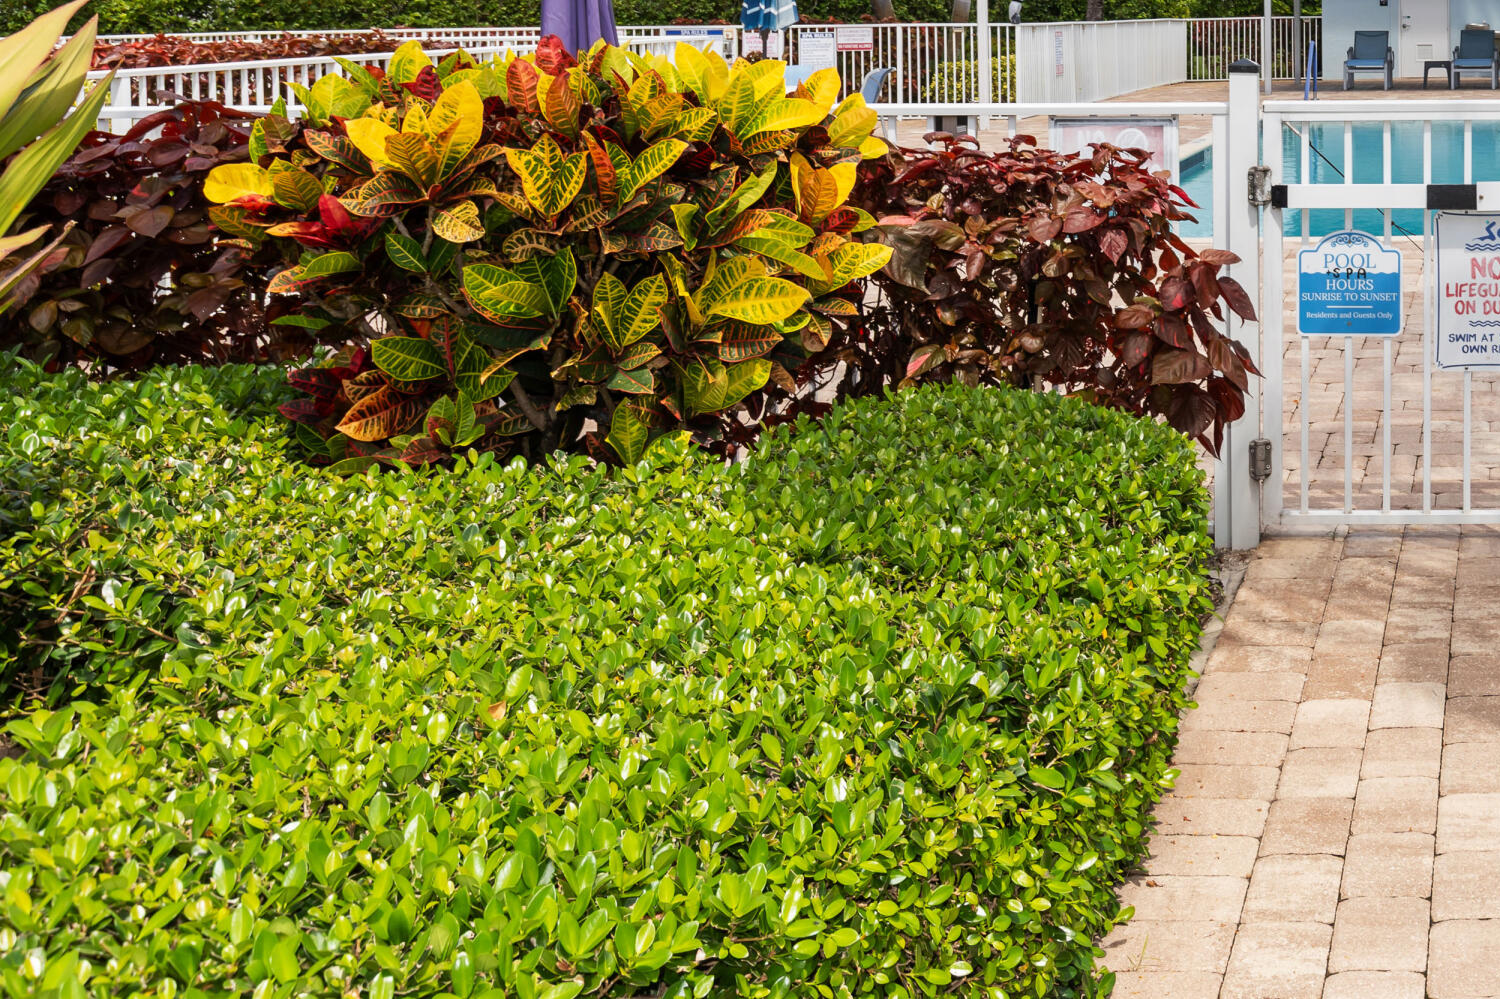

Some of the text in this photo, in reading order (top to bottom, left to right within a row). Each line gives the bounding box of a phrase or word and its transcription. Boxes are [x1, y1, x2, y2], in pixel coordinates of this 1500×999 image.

[1323, 253, 1377, 269] POOL
[1325, 279, 1375, 291] HOURS
[1302, 292, 1398, 301] SUNRISE TO SUNSET
[1454, 300, 1476, 315] ON
[1306, 311, 1393, 320] Residents and Guests Only
[1448, 333, 1477, 343] SWIM
[1481, 333, 1494, 342] AT
[1461, 344, 1487, 354] OWN
